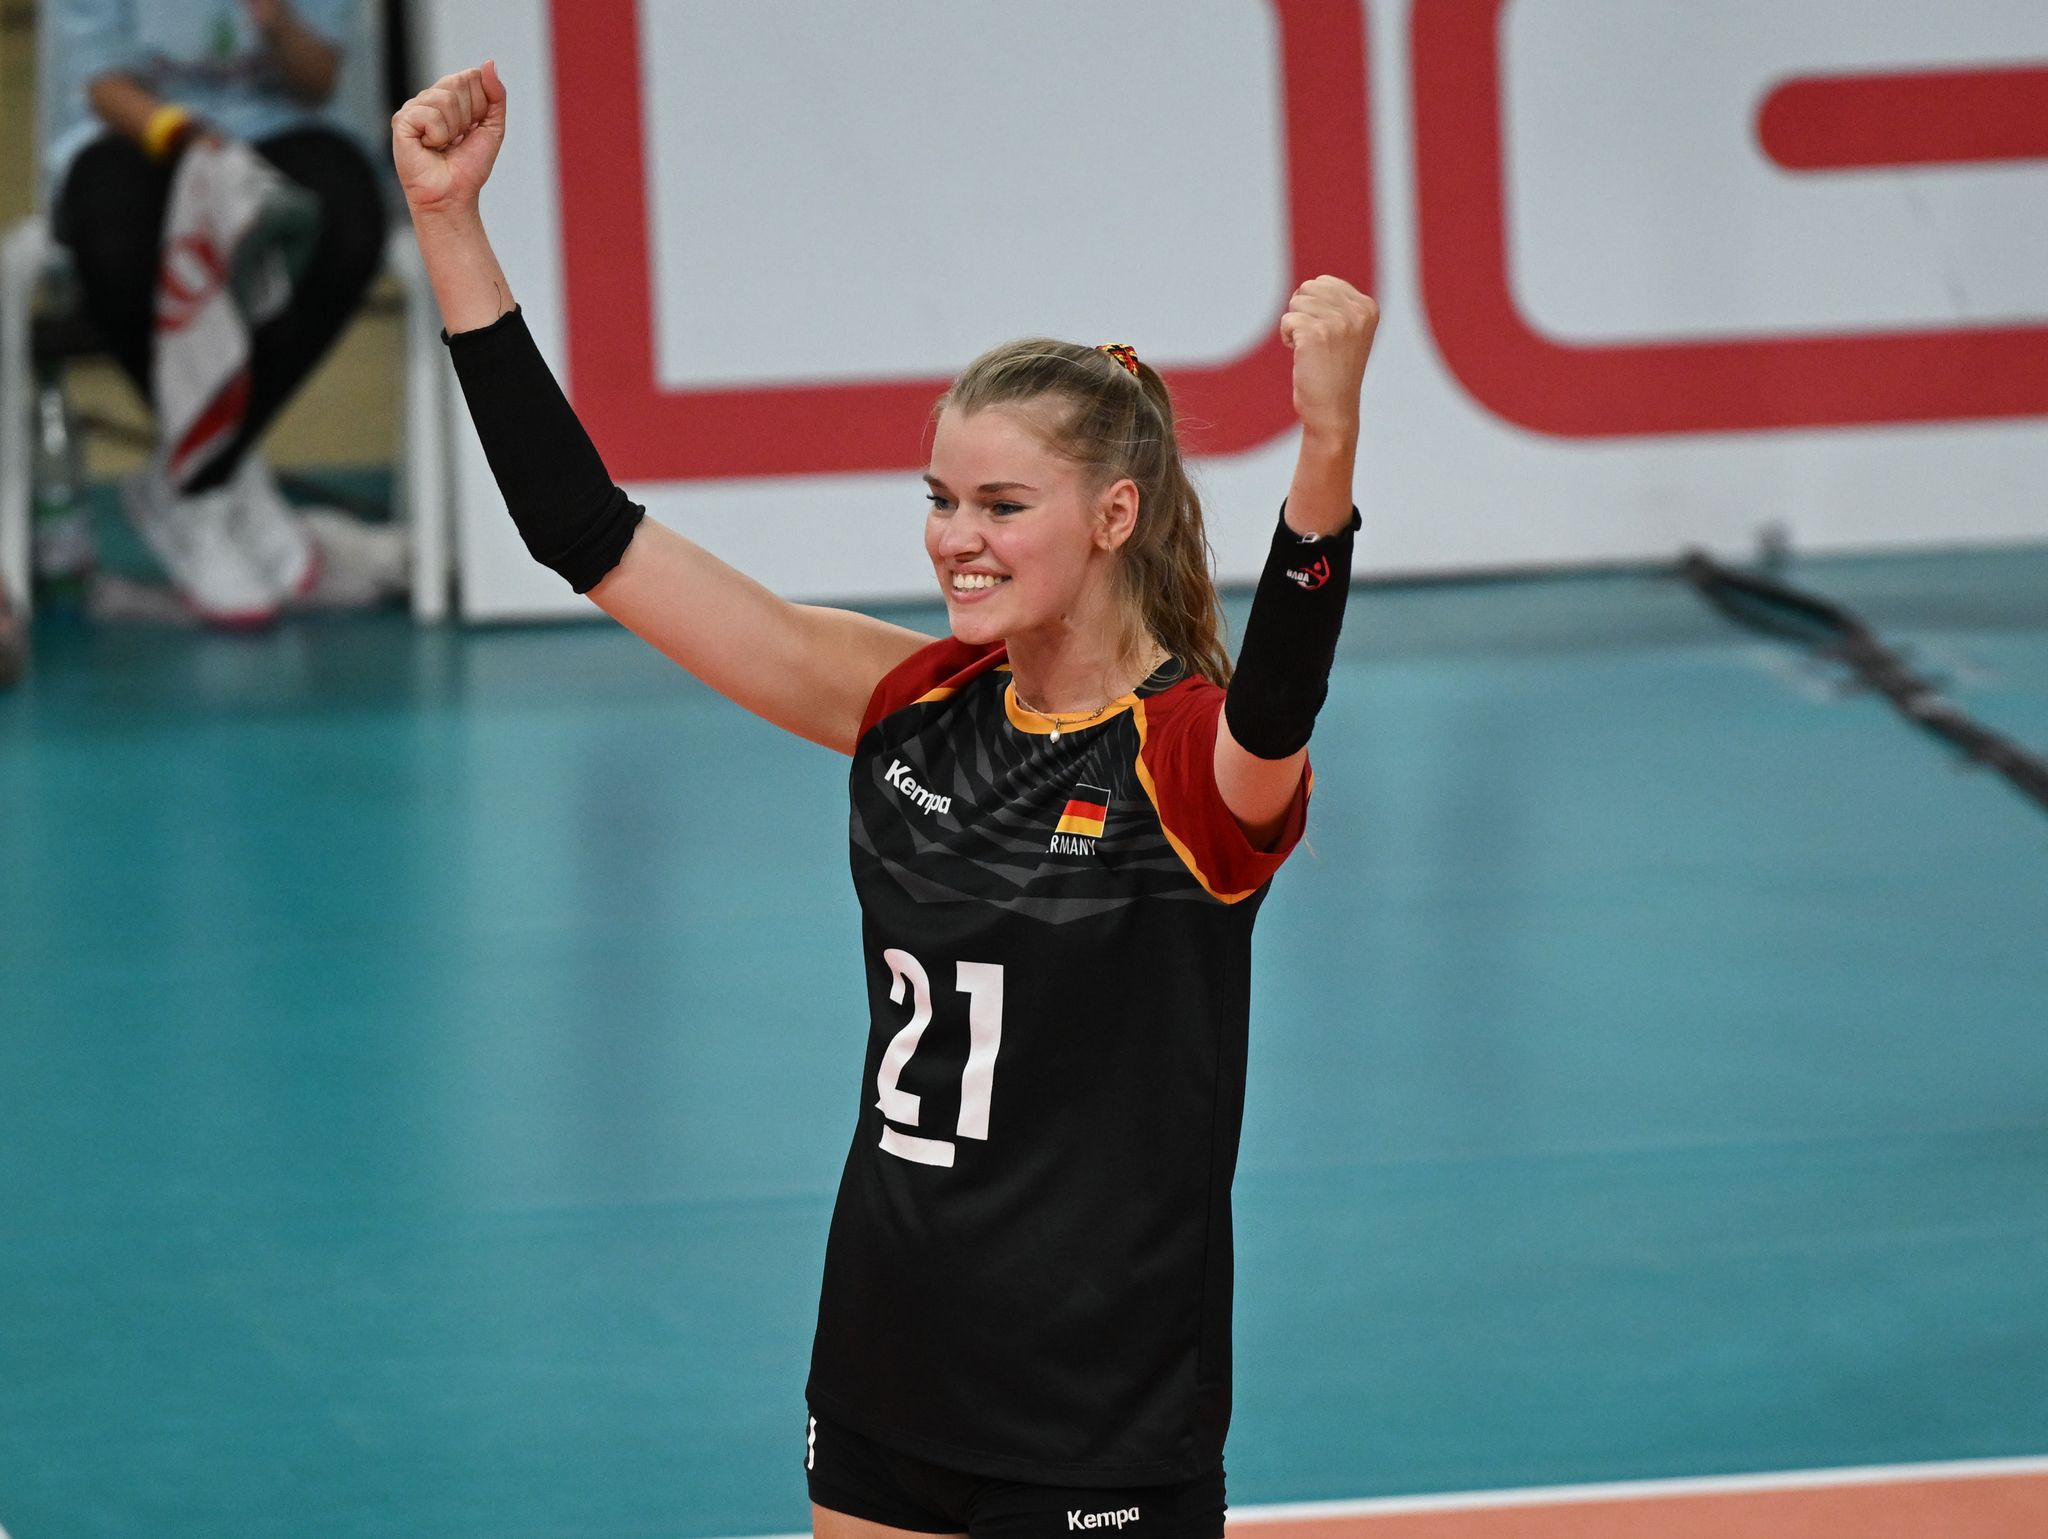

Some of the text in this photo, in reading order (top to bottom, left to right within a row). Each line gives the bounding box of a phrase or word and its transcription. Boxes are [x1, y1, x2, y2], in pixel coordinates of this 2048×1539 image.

[883, 758, 952, 816] Kempa
[1044, 834, 1096, 856] RMANY
[874, 948, 1004, 1141] 21
[1066, 1506, 1140, 1531] Kempa
